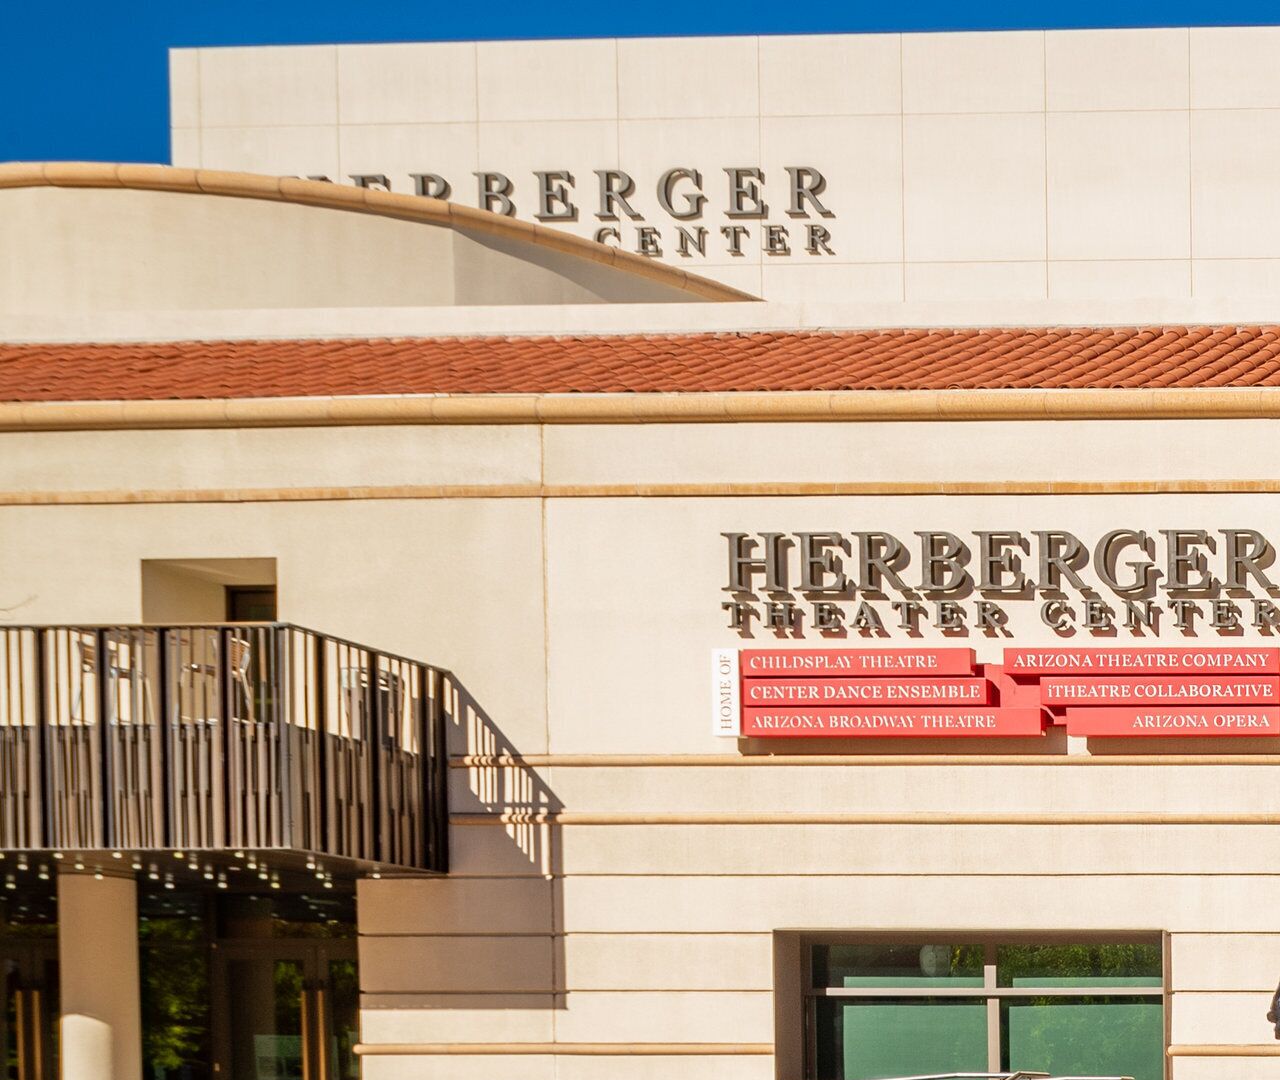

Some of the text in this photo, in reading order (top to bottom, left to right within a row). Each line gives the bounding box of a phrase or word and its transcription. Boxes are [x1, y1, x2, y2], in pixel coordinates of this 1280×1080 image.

[595, 225, 836, 257] CENTER
[720, 529, 1280, 594] HERBERGER
[721, 599, 1010, 632] THEATER
[750, 655, 937, 669] CHILDSPLAY THEATRE
[1014, 653, 1269, 667] ARIZONA THEATRE COMPANY
[719, 654, 733, 729] HOME OF
[750, 684, 980, 699] CENTER DANCE ENSEMBLE
[1047, 684, 1273, 698] iTHEATRE COLLABORATIVE
[752, 715, 996, 729] ARIZONA BROADWAY THEATRE
[1133, 714, 1269, 728] ARIZONA OPERA
